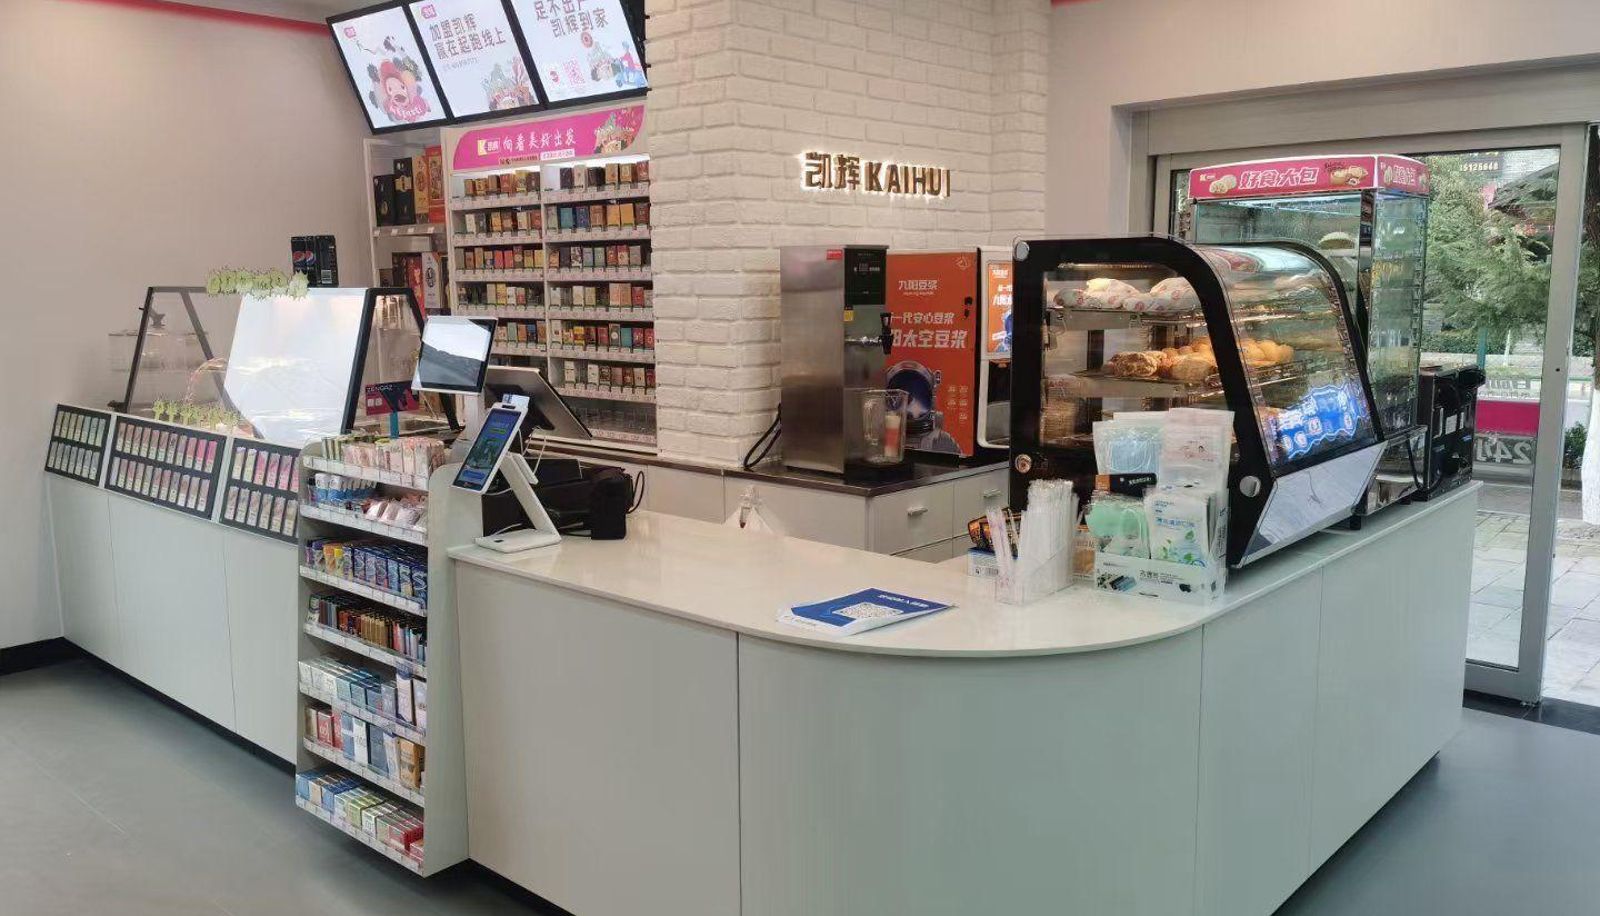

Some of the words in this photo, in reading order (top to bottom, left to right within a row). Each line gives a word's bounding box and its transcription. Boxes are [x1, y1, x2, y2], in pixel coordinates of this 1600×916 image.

[429, 13, 477, 42] 加盟凯辉
[550, 7, 609, 38] 凯辉到家
[434, 27, 507, 60] 赢在起跑线上
[503, 128, 577, 152] 向着美好出发
[805, 152, 861, 190] 凯辉
[865, 161, 951, 198] KAIHUI
[1238, 167, 1320, 190] 好食大包
[898, 279, 938, 290] 九阳豆浆
